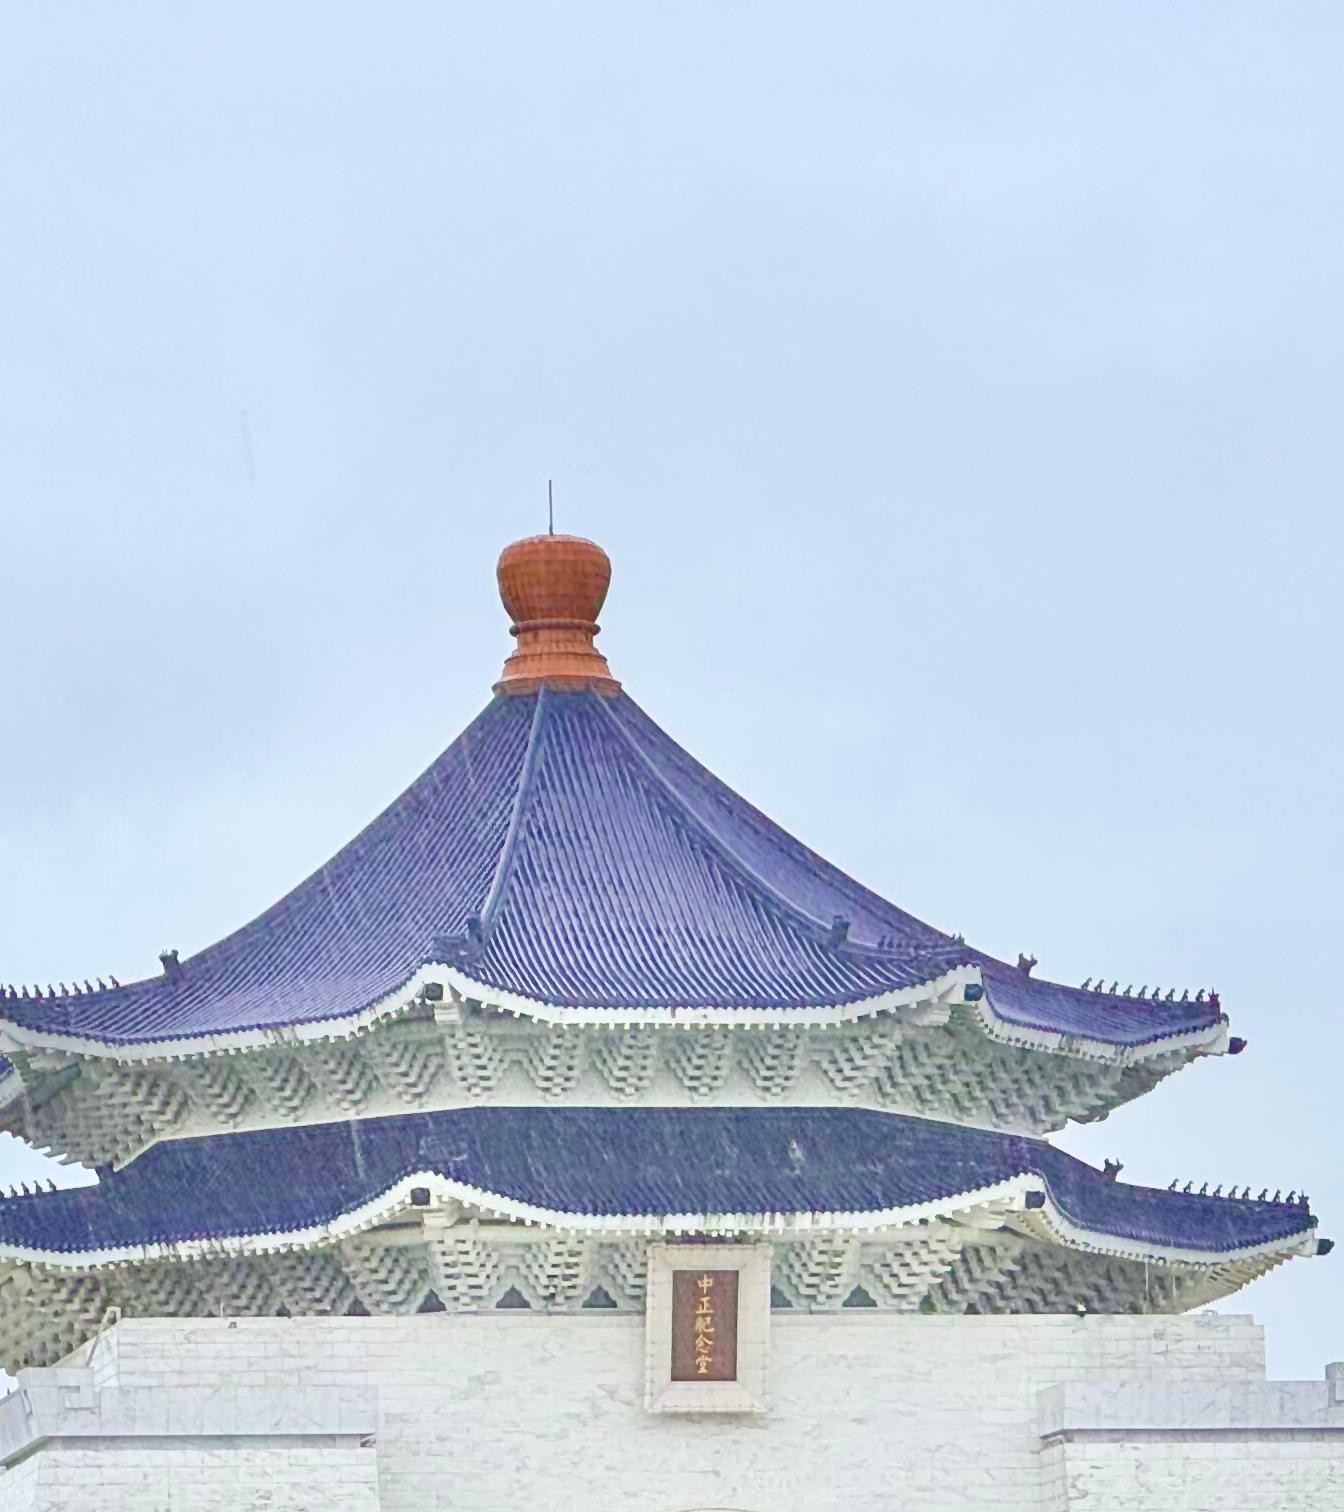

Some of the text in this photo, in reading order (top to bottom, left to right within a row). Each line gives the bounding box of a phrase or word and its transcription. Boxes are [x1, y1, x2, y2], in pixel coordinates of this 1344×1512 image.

[695, 1274, 715, 1374] 中正紀念堂
